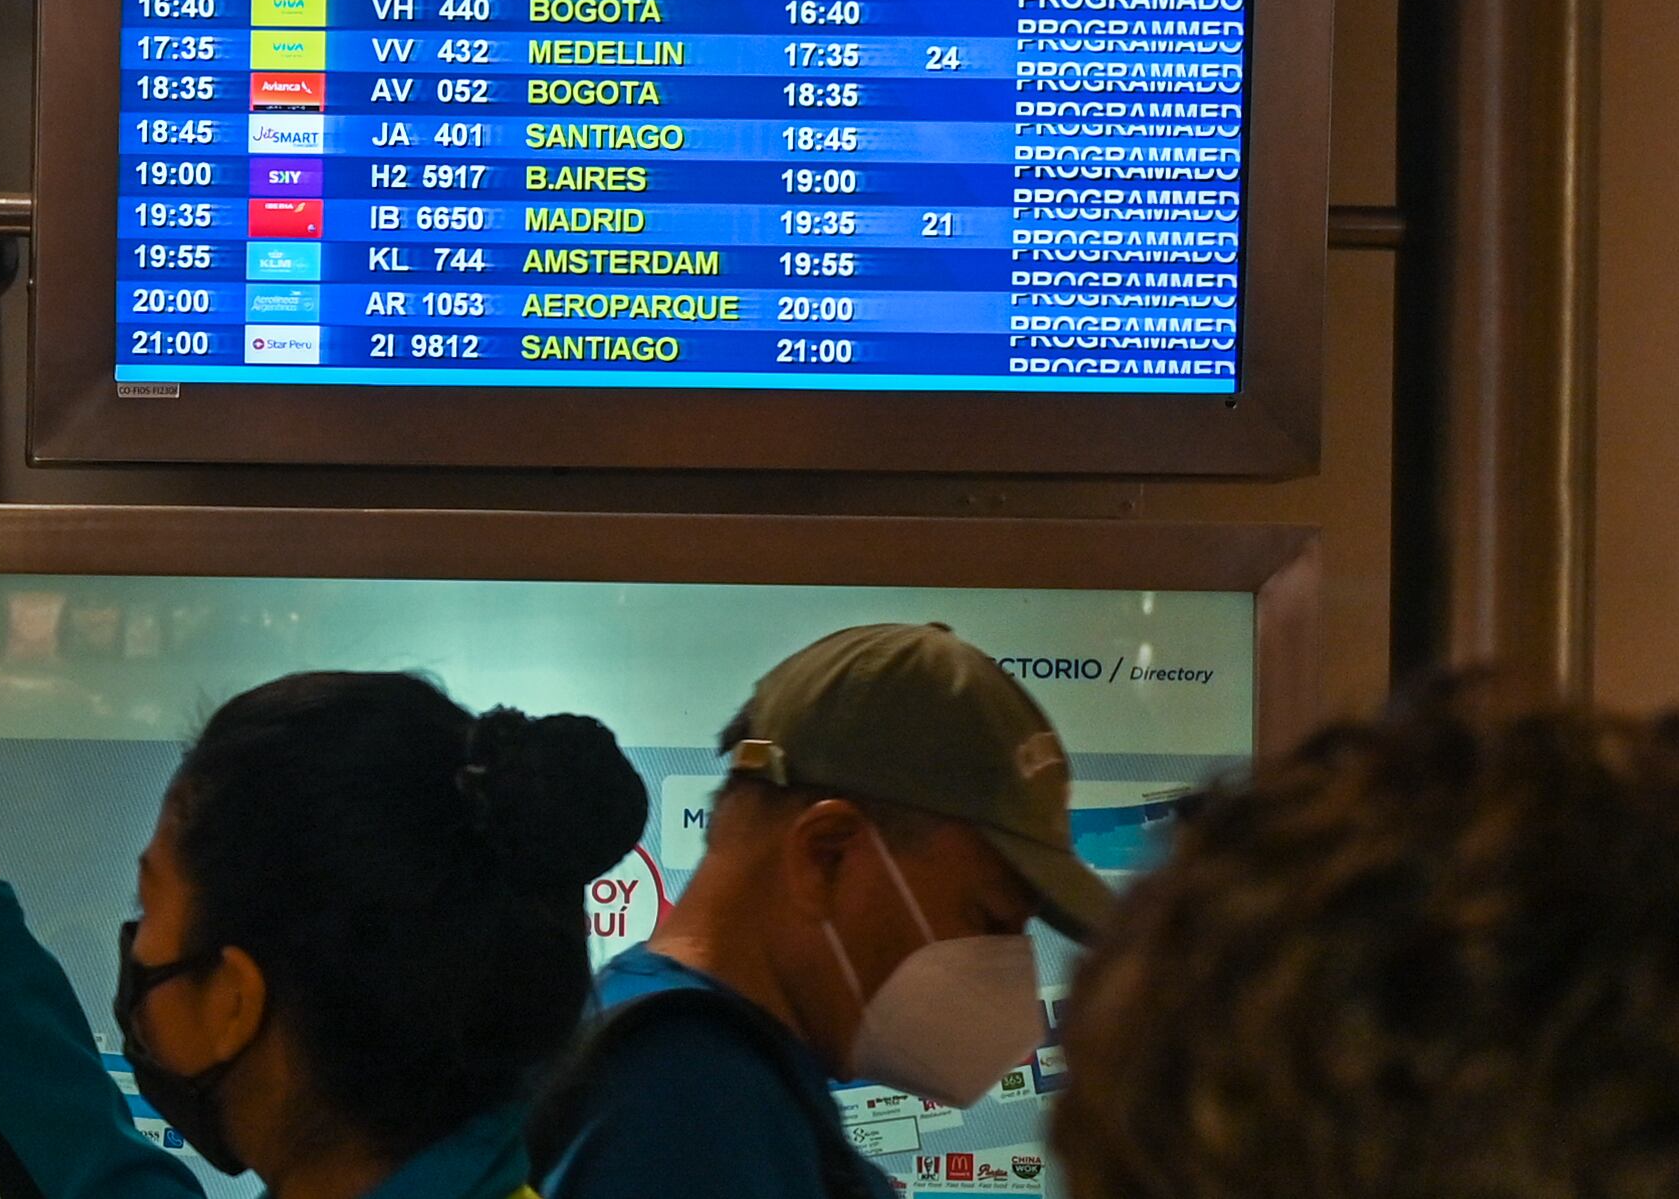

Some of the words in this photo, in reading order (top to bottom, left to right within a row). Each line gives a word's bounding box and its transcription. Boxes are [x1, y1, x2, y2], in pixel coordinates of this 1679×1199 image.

[137, 120, 213, 143] 18:45
[372, 123, 409, 145] JA
[434, 123, 481, 146] 401
[526, 124, 682, 149] SANTIAGO
[783, 127, 859, 150] 18:45
[132, 331, 207, 354] 21:00
[267, 339, 287, 349] Star
[412, 335, 479, 357] 9812
[522, 335, 678, 361] SANTIAGO
[777, 339, 851, 362] 21:00
[988, 658, 1103, 680] CTORIO
[1130, 666, 1213, 683] Directory
[1011, 1156, 1041, 1164] CHINA
[1015, 1165, 1038, 1173] WOK
